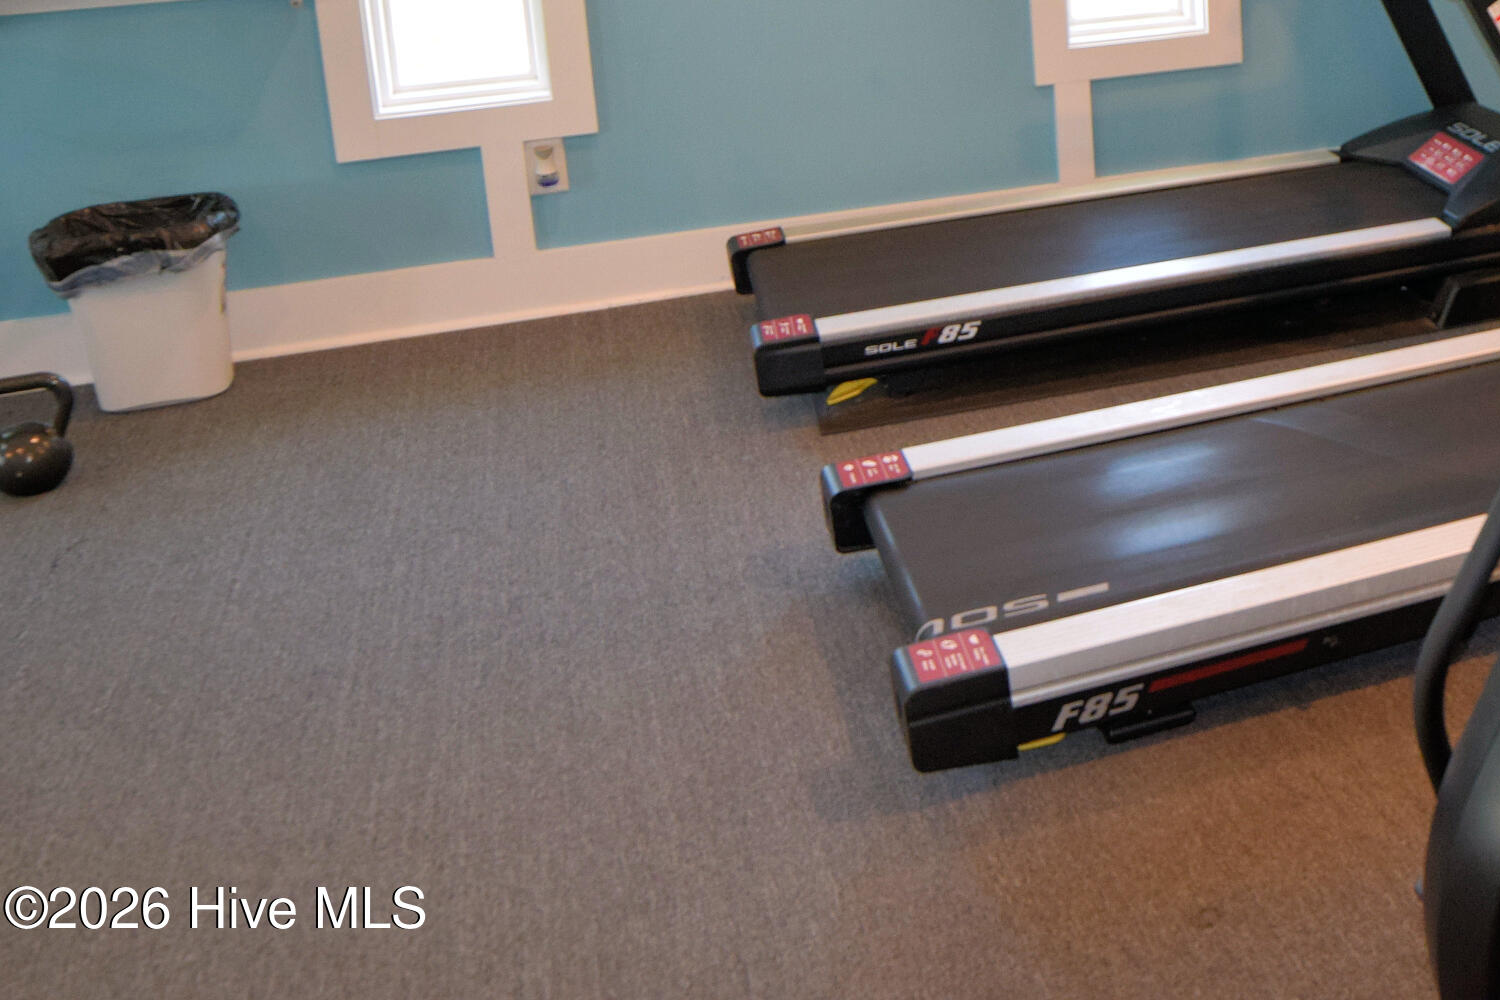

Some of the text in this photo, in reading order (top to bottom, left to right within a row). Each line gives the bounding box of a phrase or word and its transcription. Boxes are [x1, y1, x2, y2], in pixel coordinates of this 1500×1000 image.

[865, 320, 982, 356] SOLE F85
[1051, 682, 1145, 733] F85
